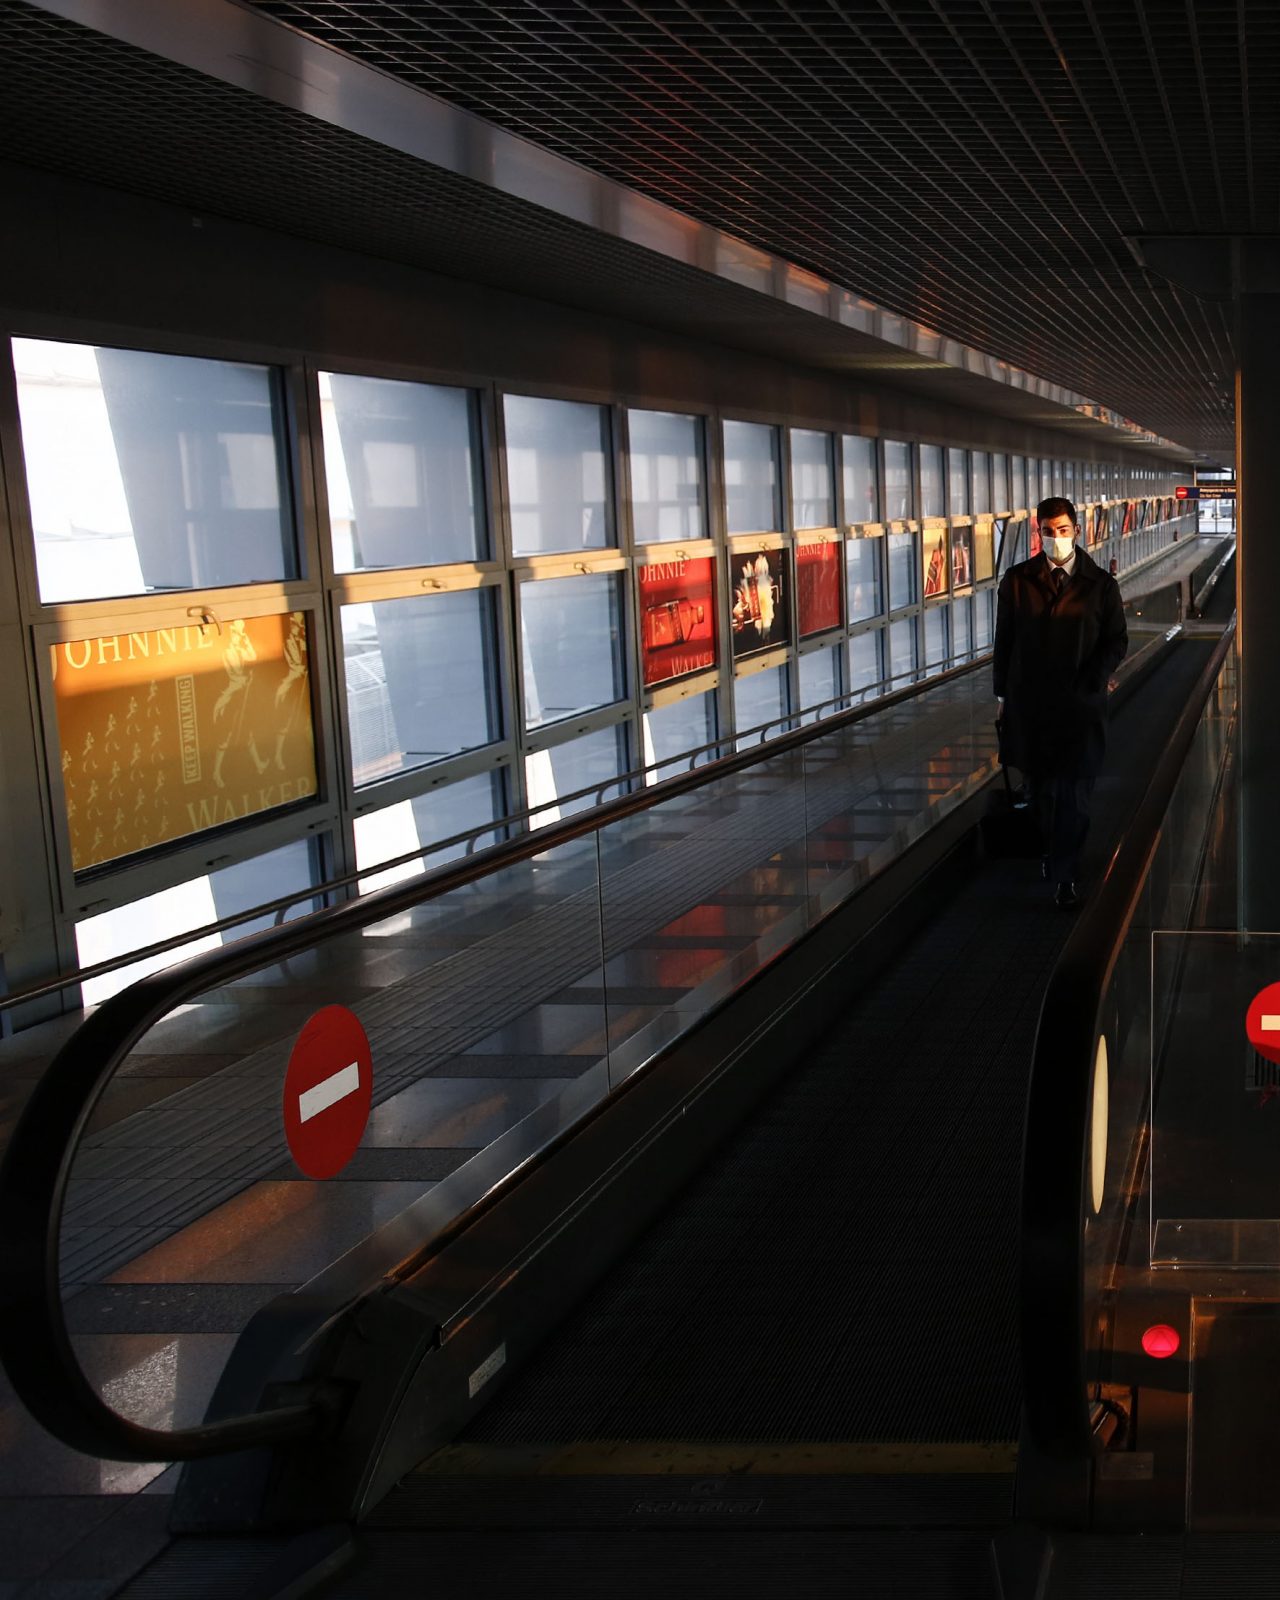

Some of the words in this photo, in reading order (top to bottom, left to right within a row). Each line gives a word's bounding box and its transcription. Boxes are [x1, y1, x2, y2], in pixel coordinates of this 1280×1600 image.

[639, 561, 686, 584] OHNNIE
[179, 678, 195, 744] WALKING
[184, 745, 198, 780] KEEP
